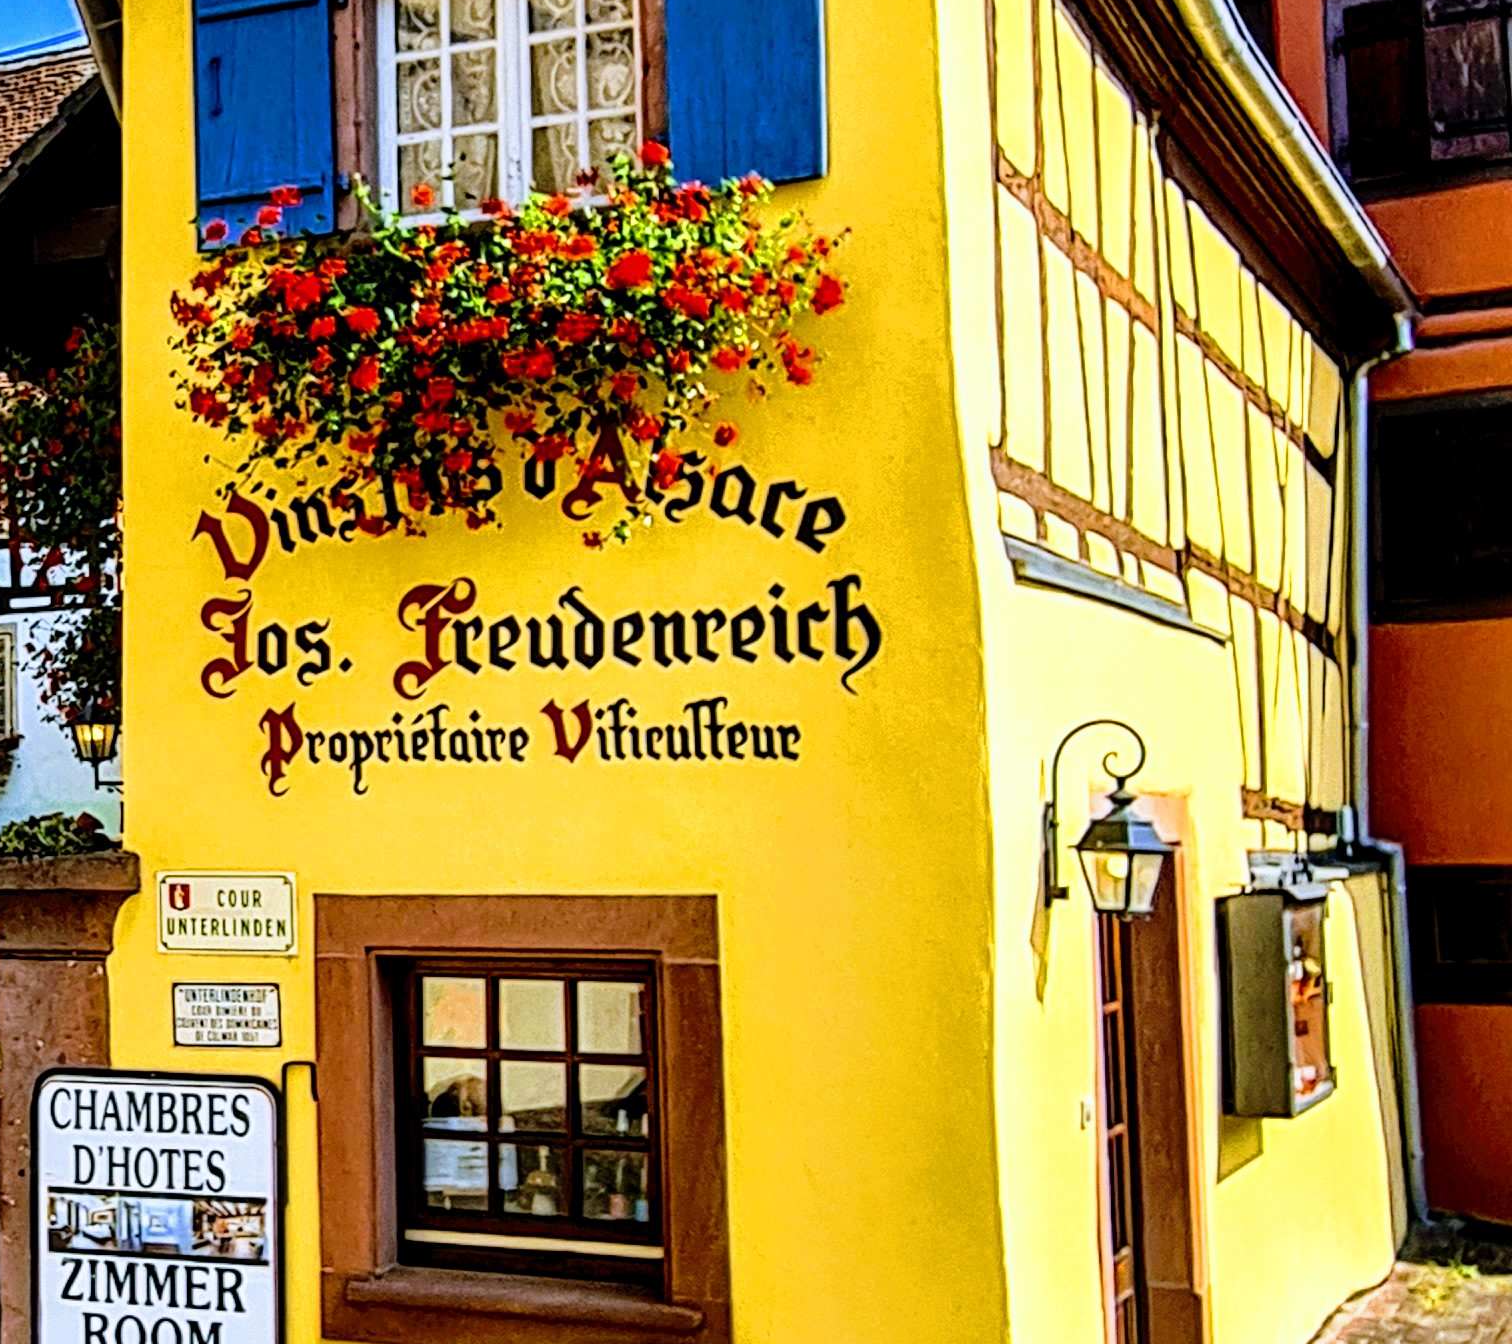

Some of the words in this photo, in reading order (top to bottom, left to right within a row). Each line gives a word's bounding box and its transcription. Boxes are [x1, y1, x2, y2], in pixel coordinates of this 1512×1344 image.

[514, 412, 846, 554] dAlsace
[200, 589, 353, 699] Jos.
[393, 574, 882, 700] Freudenreich
[259, 702, 530, 796] Propriétaire
[540, 696, 801, 763] Viticulteur
[217, 889, 263, 908] COUR
[166, 917, 287, 938] UNTERLINDEN
[49, 1087, 251, 1137] CHAMBRES
[73, 1144, 227, 1193] D'HOTES
[59, 1257, 247, 1313] ZIMMER
